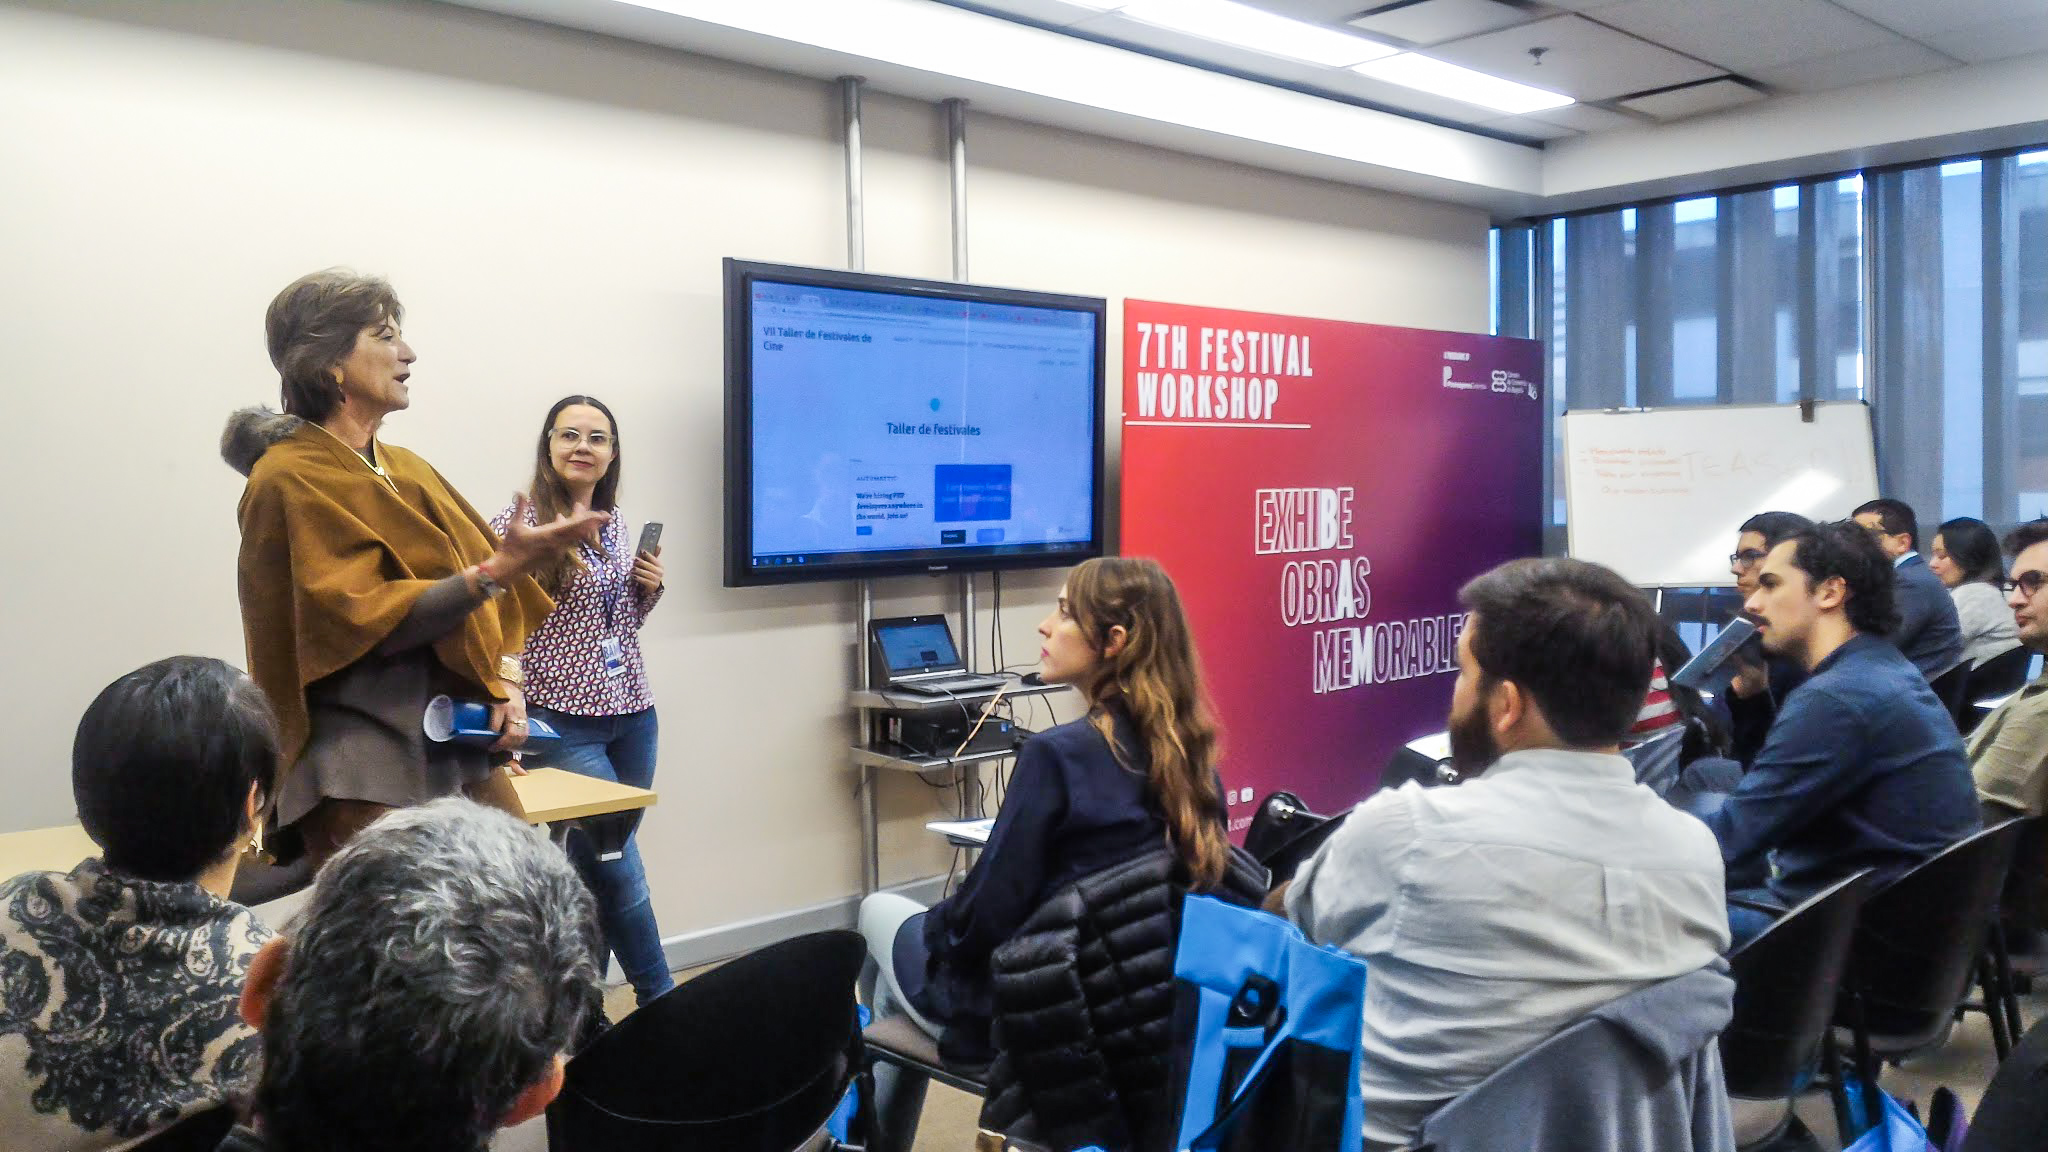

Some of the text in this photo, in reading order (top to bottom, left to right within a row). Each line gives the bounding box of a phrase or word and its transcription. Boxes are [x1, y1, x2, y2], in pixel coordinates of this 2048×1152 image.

[763, 326, 872, 343] VII Taller de Festivales de
[763, 340, 784, 351] Cine
[1137, 322, 1313, 377] 7TH FESTIVAL
[1137, 372, 1280, 420] WORKSHOP
[886, 422, 916, 435] Taller
[918, 423, 932, 435] de
[1255, 487, 1354, 555] EXHIBE
[1281, 556, 1371, 626] OBRAS
[1313, 611, 1472, 694] MEMORABLE
